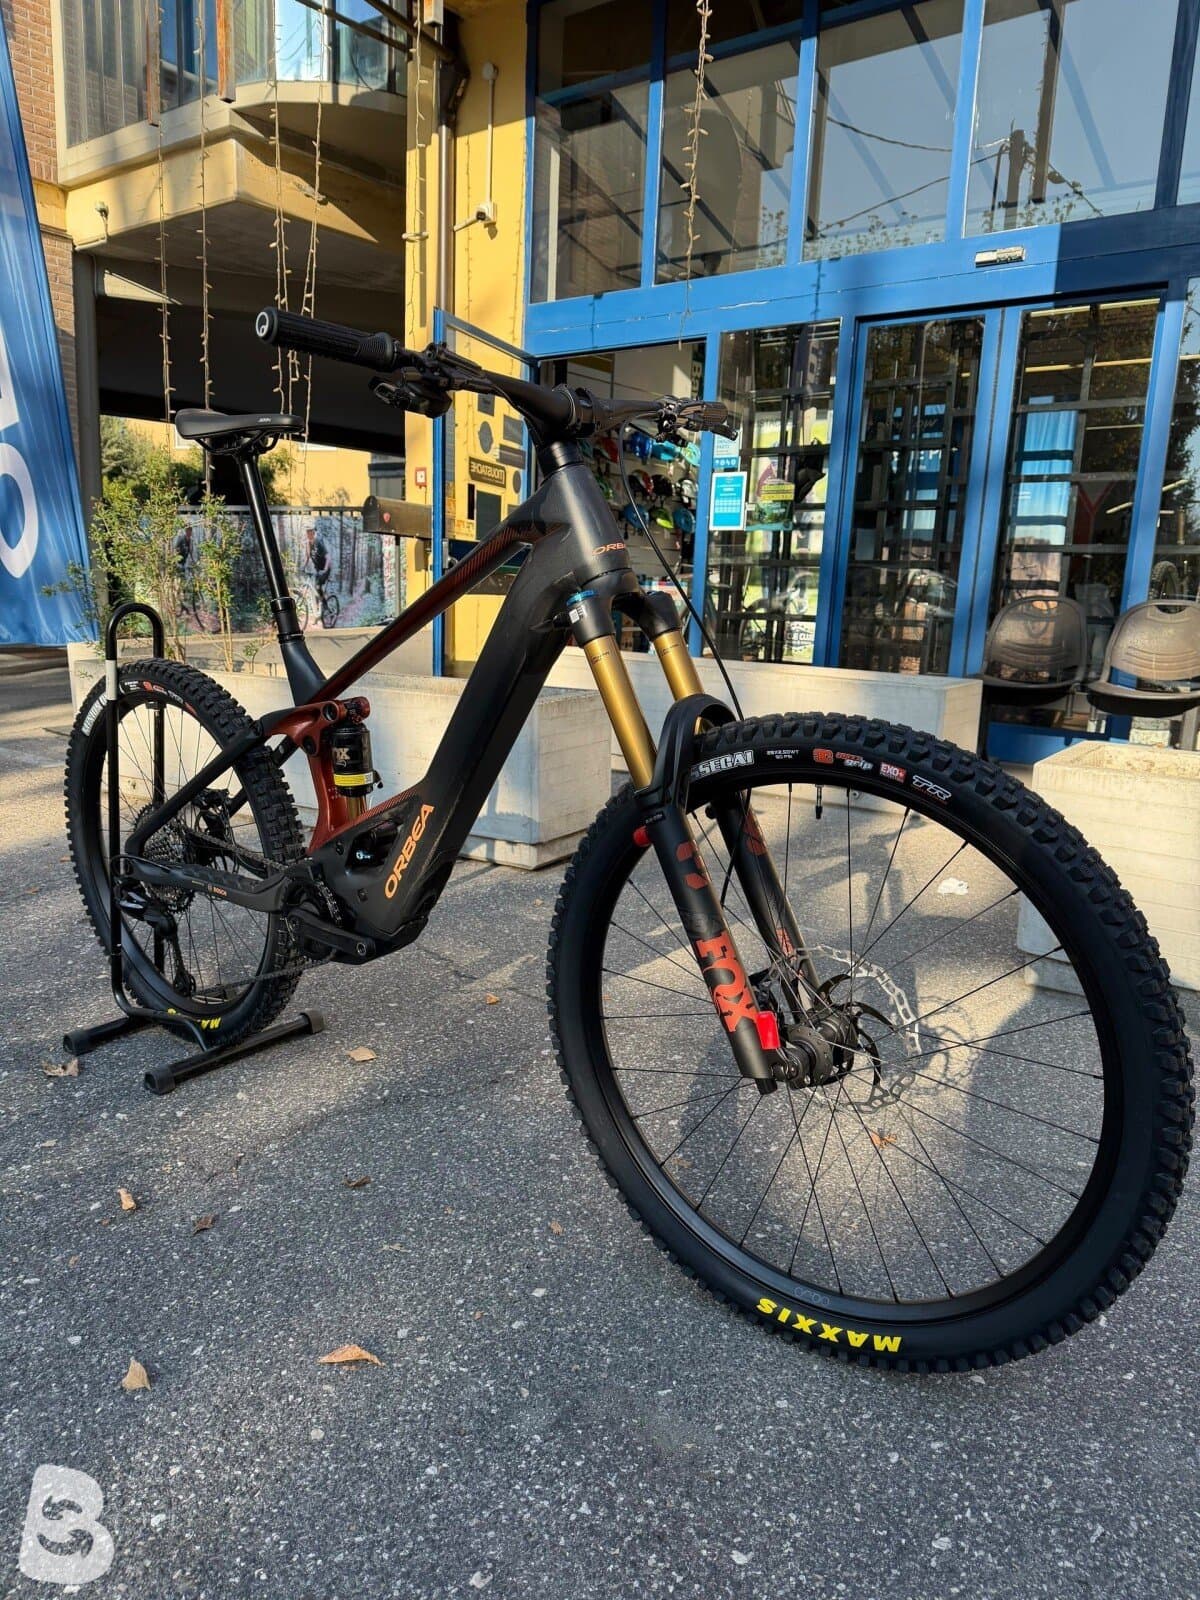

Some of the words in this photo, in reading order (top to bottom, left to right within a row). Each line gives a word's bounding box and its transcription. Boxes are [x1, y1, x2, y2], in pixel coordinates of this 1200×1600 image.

[591, 543, 627, 556] ORB
[384, 804, 435, 899] ORBEA
[695, 930, 760, 1033] FOX
[756, 1297, 902, 1353] MAXXIS
